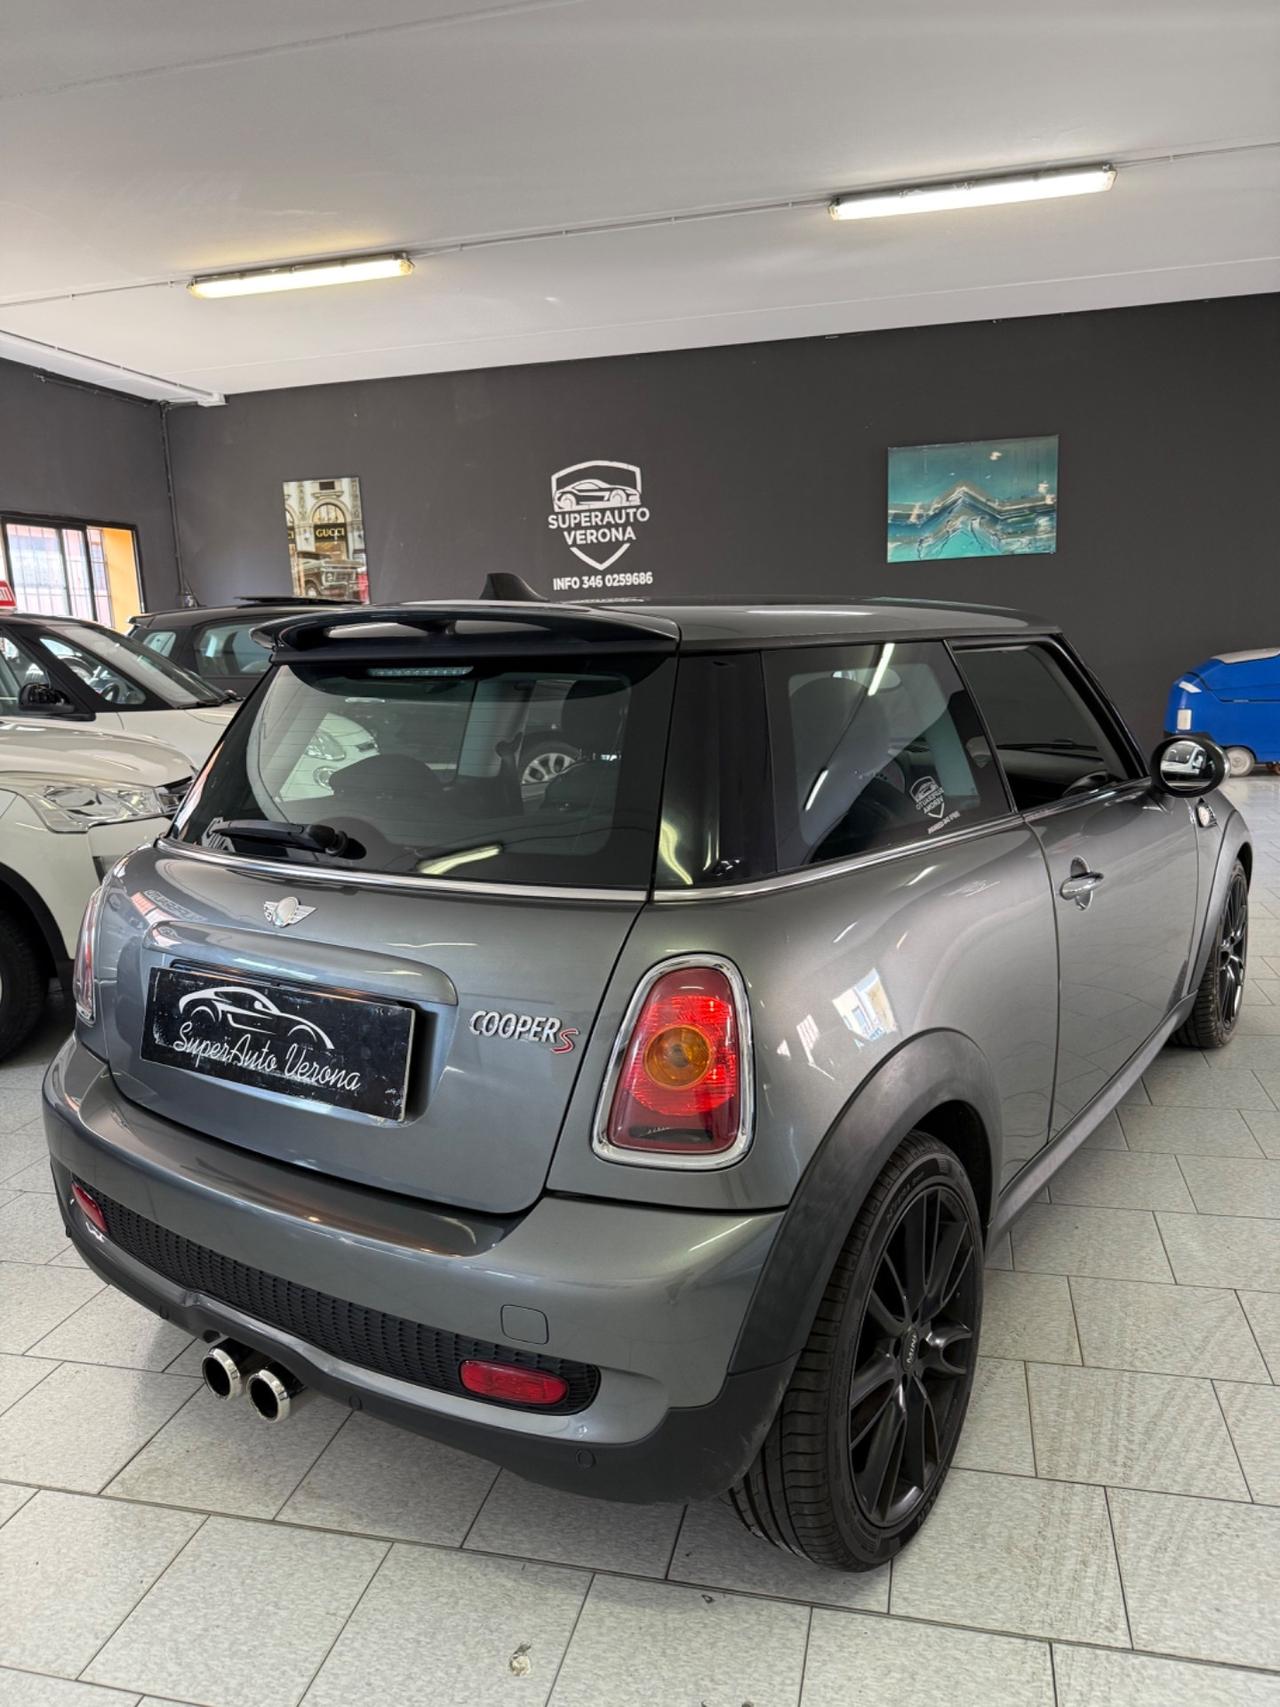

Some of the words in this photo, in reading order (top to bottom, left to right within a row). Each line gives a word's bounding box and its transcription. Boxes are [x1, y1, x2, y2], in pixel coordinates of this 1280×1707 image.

[548, 507, 650, 529] SUPERAUTO
[315, 528, 345, 538] GUCCI
[563, 526, 637, 546] VERONA
[553, 577, 580, 591] INFO
[582, 575, 603, 589] 346
[605, 572, 653, 587] 0259686
[469, 1010, 561, 1044] COOPER
[550, 1028, 579, 1054] S
[173, 1021, 278, 1068] SuperAuto
[284, 1042, 361, 1091] Verona
